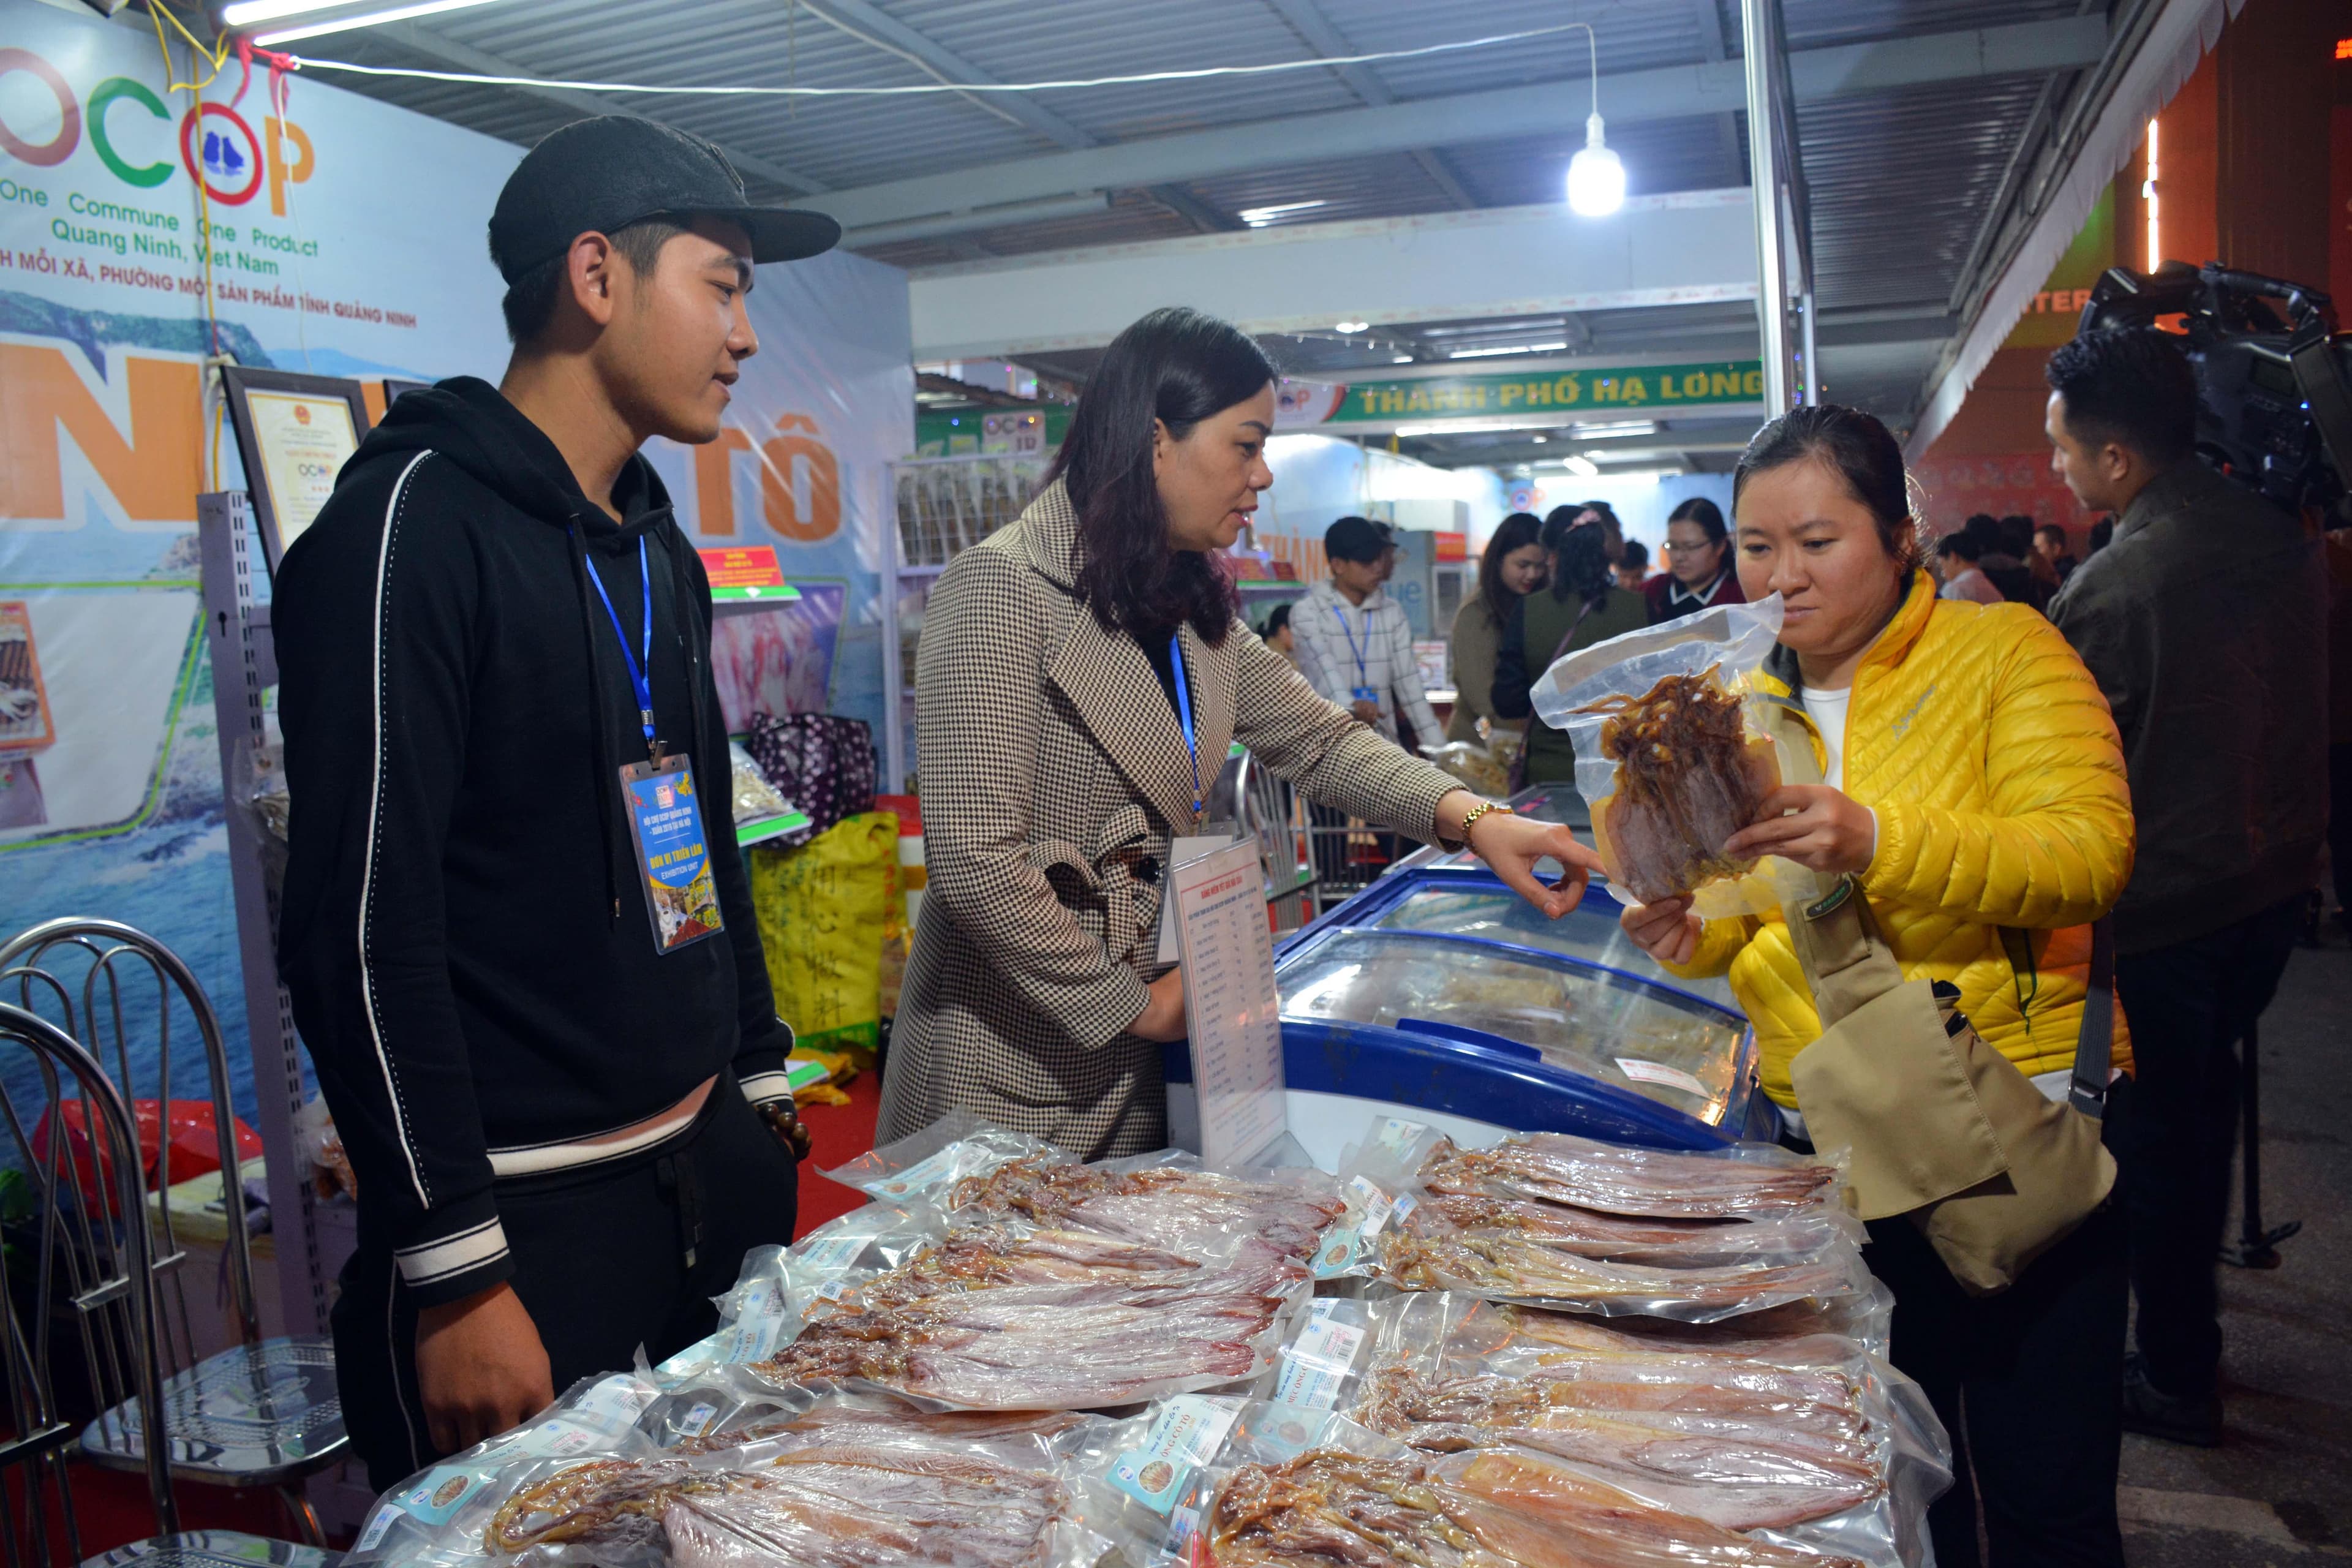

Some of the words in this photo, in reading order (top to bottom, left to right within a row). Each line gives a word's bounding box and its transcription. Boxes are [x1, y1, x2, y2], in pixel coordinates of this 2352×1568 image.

[0, 47, 315, 217] OCOP
[0, 179, 48, 206] One
[69, 192, 179, 231] Commune
[51, 217, 127, 255] Quang
[133, 232, 187, 263] Ninh,
[238, 253, 279, 276] Nam
[99, 265, 174, 292] PHƯỜNG
[385, 311, 417, 328] NINH
[1359, 383, 1486, 415] THÀNH
[1499, 372, 1581, 407] PHỐ
[1593, 377, 1648, 406] HẠ
[1660, 370, 1764, 399] LONG
